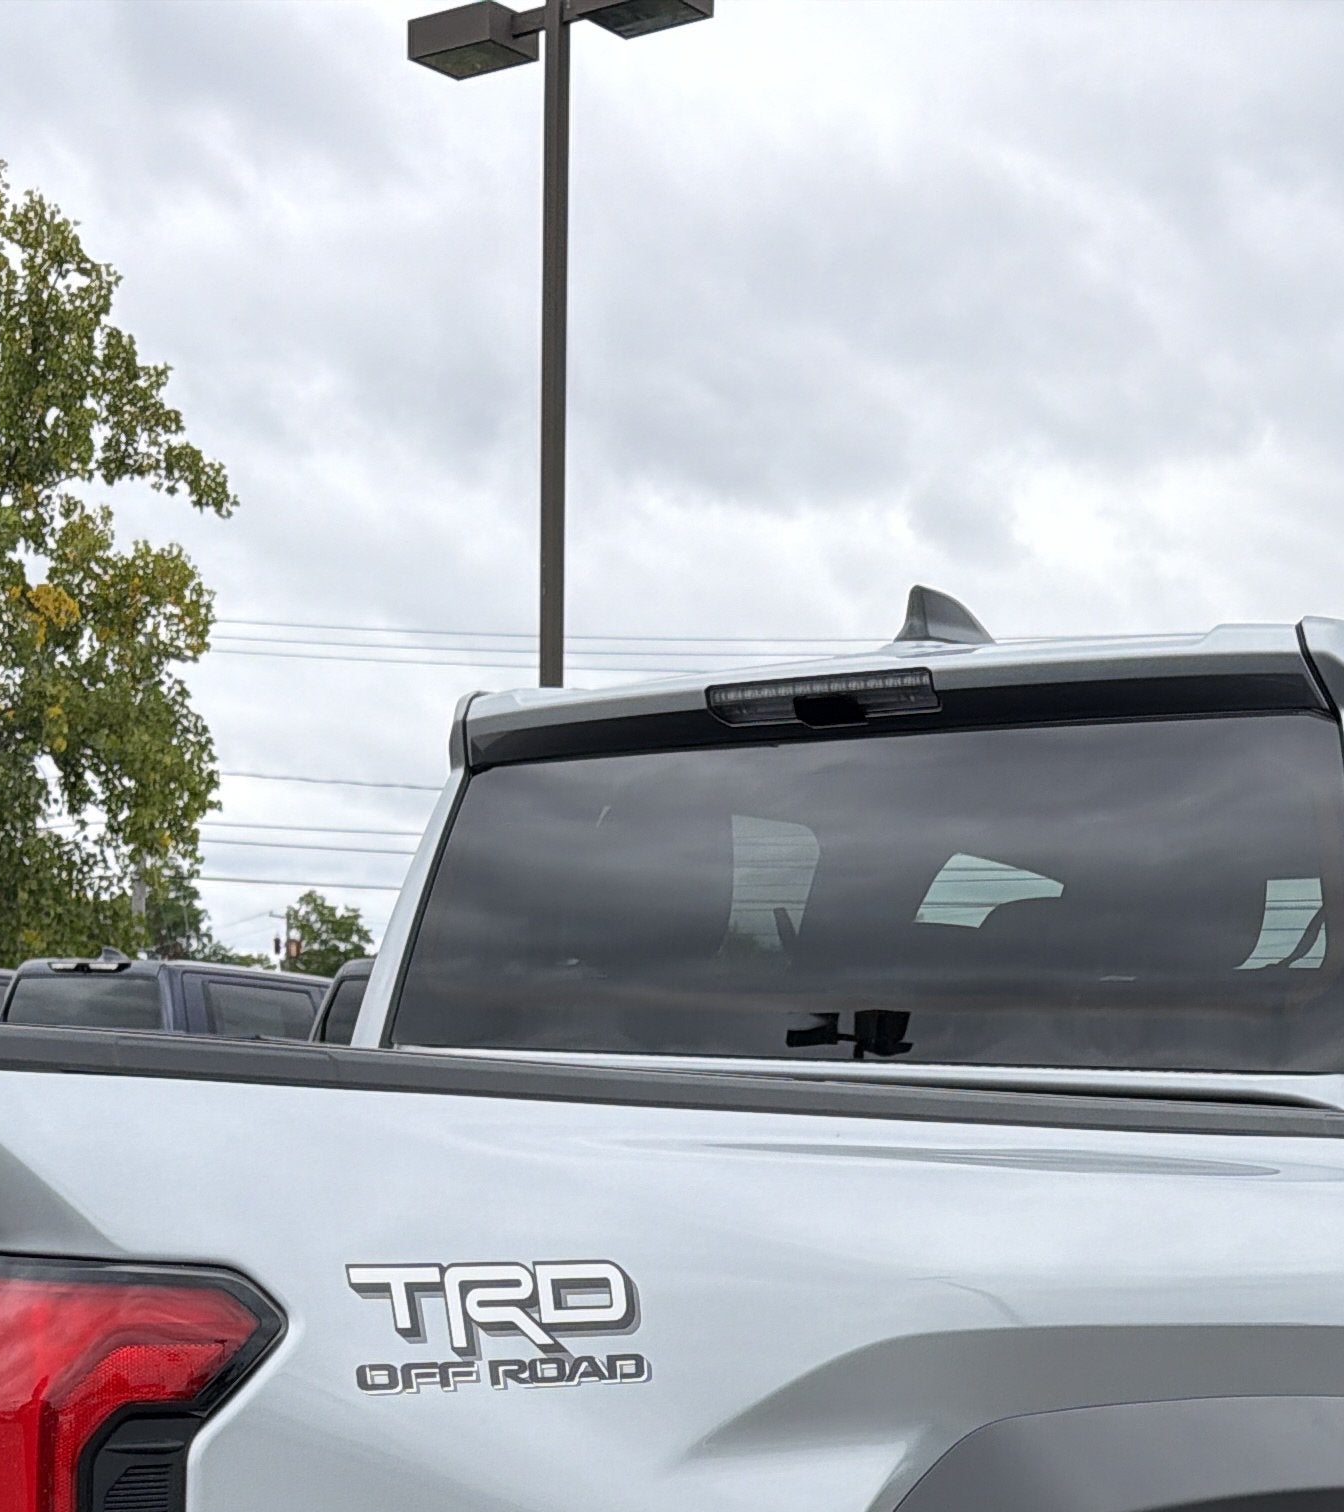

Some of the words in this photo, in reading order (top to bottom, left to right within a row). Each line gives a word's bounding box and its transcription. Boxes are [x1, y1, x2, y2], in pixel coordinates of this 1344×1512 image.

[345, 1259, 641, 1361] TRD
[355, 1361, 481, 1395] OFF
[487, 1353, 653, 1391] ROAD
